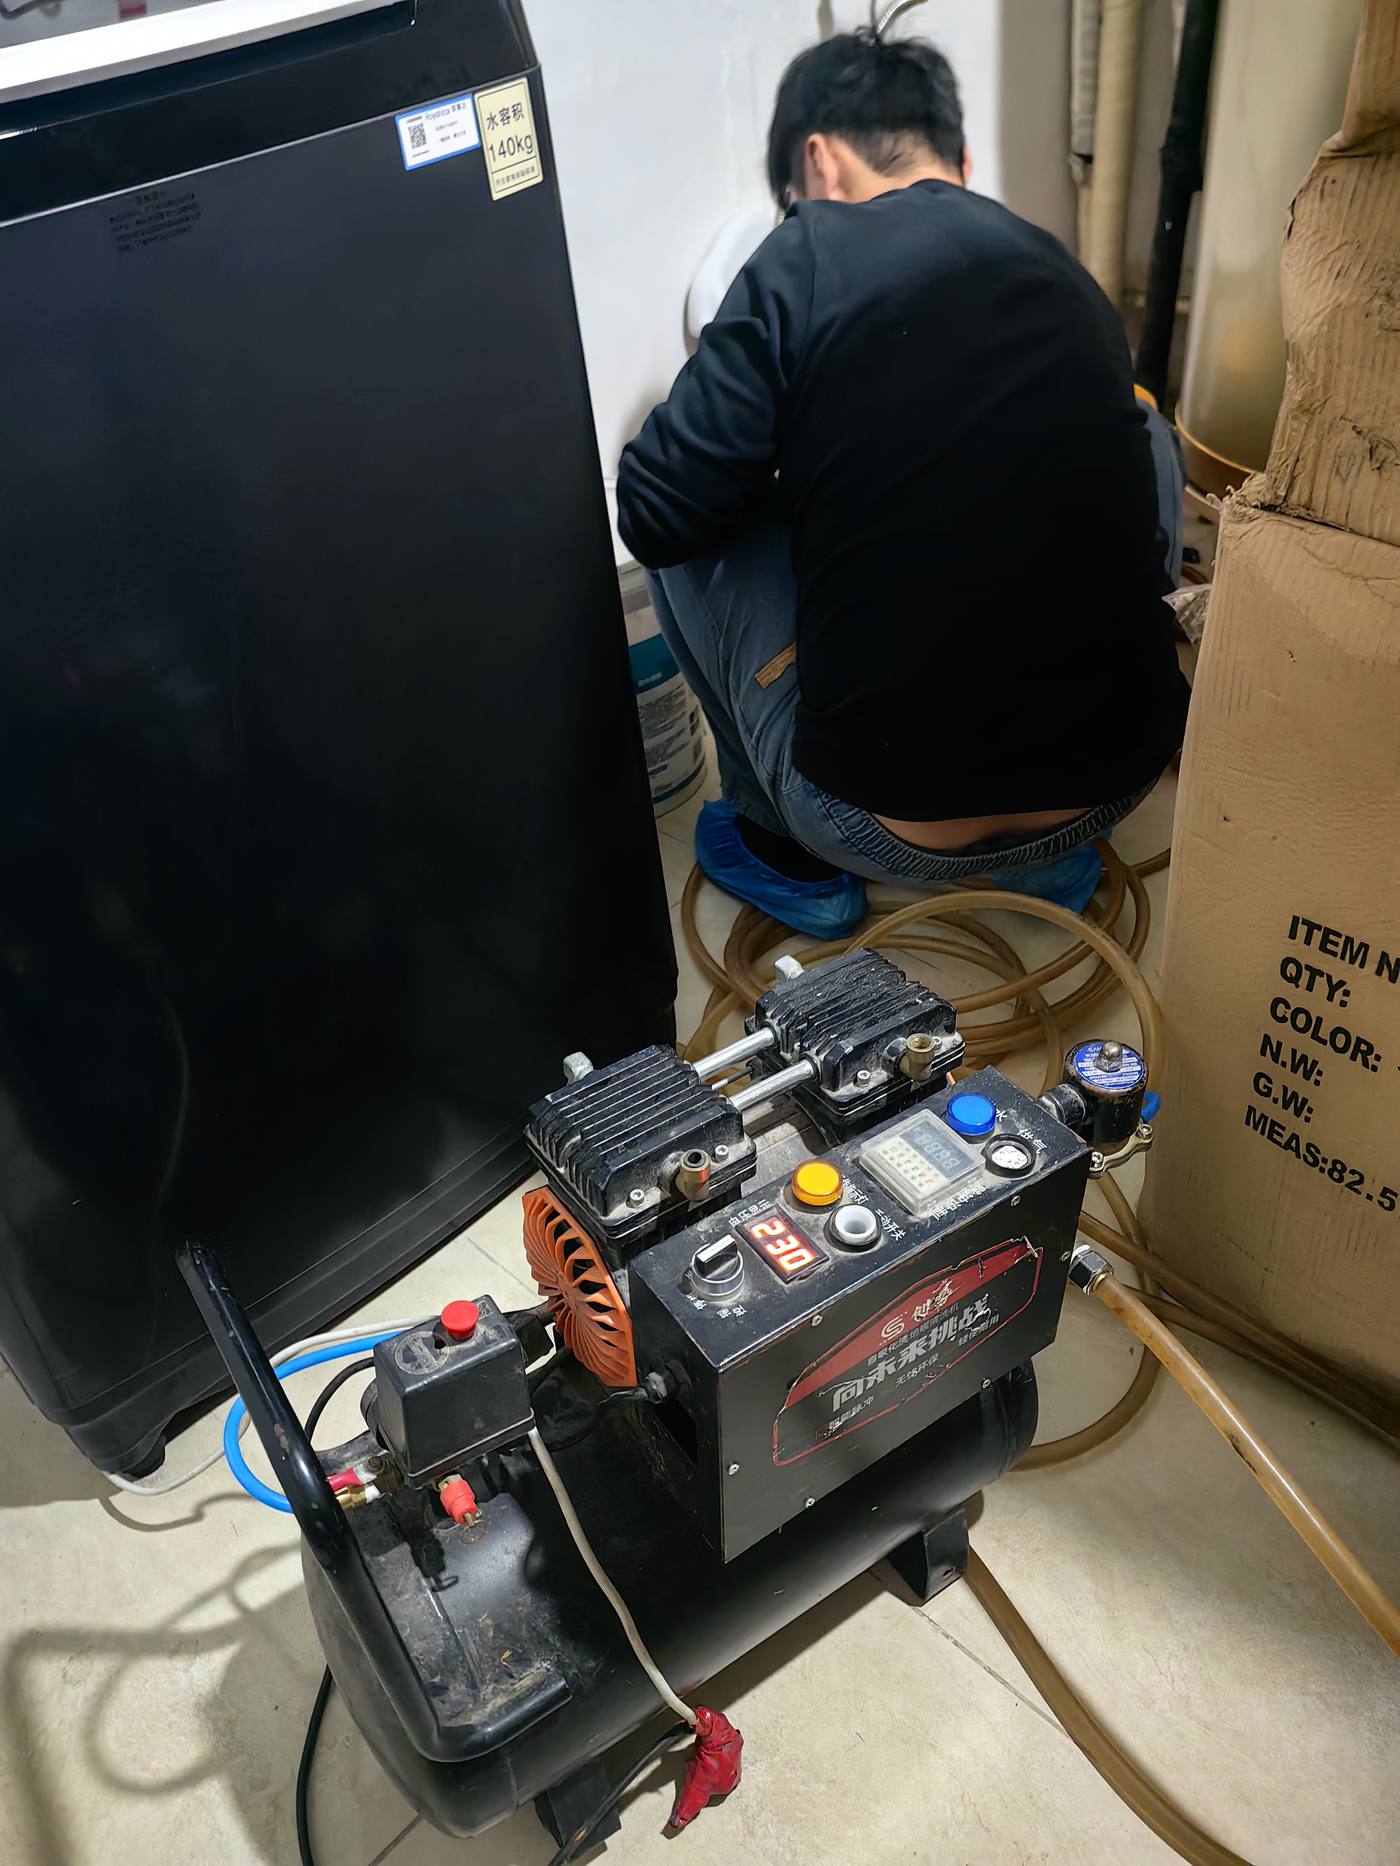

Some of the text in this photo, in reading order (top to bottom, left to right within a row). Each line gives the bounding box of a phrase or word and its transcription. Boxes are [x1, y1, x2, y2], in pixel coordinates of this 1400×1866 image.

[487, 102, 524, 130] 水容积
[488, 134, 534, 162] 140kg
[1288, 915, 1370, 969] ITEM
[1279, 956, 1351, 1008] QTY:
[1259, 1033, 1323, 1087] N.W:
[1270, 997, 1382, 1073] COLOR:
[1253, 1072, 1314, 1123] G.W:
[728, 1199, 773, 1227] 电压显示
[752, 1219, 814, 1272] 230
[832, 1294, 991, 1412] 向未来挑战
